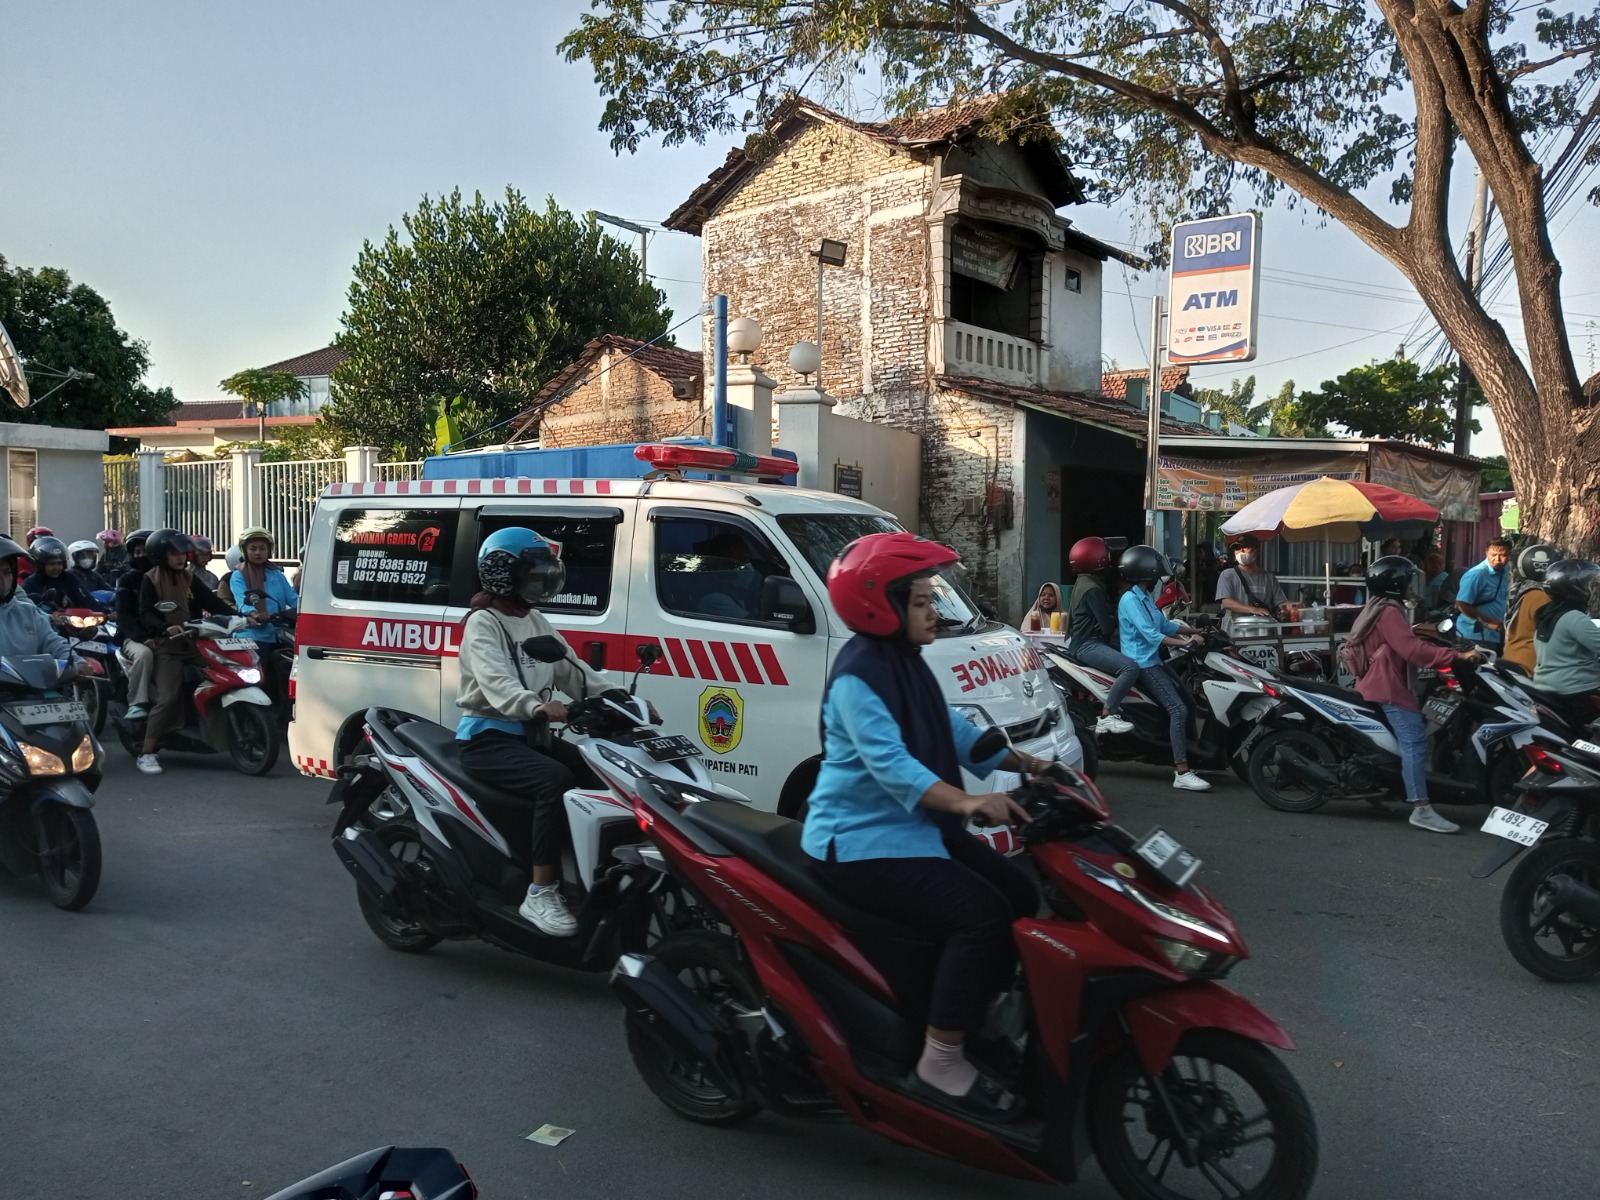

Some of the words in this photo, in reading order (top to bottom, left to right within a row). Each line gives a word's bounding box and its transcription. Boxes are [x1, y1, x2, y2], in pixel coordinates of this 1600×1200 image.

[1207, 231, 1242, 254] BRI
[1182, 289, 1239, 311] ATM
[387, 532, 417, 546] GRATIS
[424, 536, 437, 546] 24
[355, 558, 378, 569] 0813
[379, 559, 404, 571] 9385
[405, 560, 428, 572] 5811
[353, 569, 375, 582] 0812
[376, 571, 400, 583] 9075
[401, 572, 426, 585] 9522
[547, 592, 582, 605] amatkan
[582, 594, 598, 606] Jiwa
[738, 763, 758, 776] PATI
[1501, 812, 1527, 827] 4892
